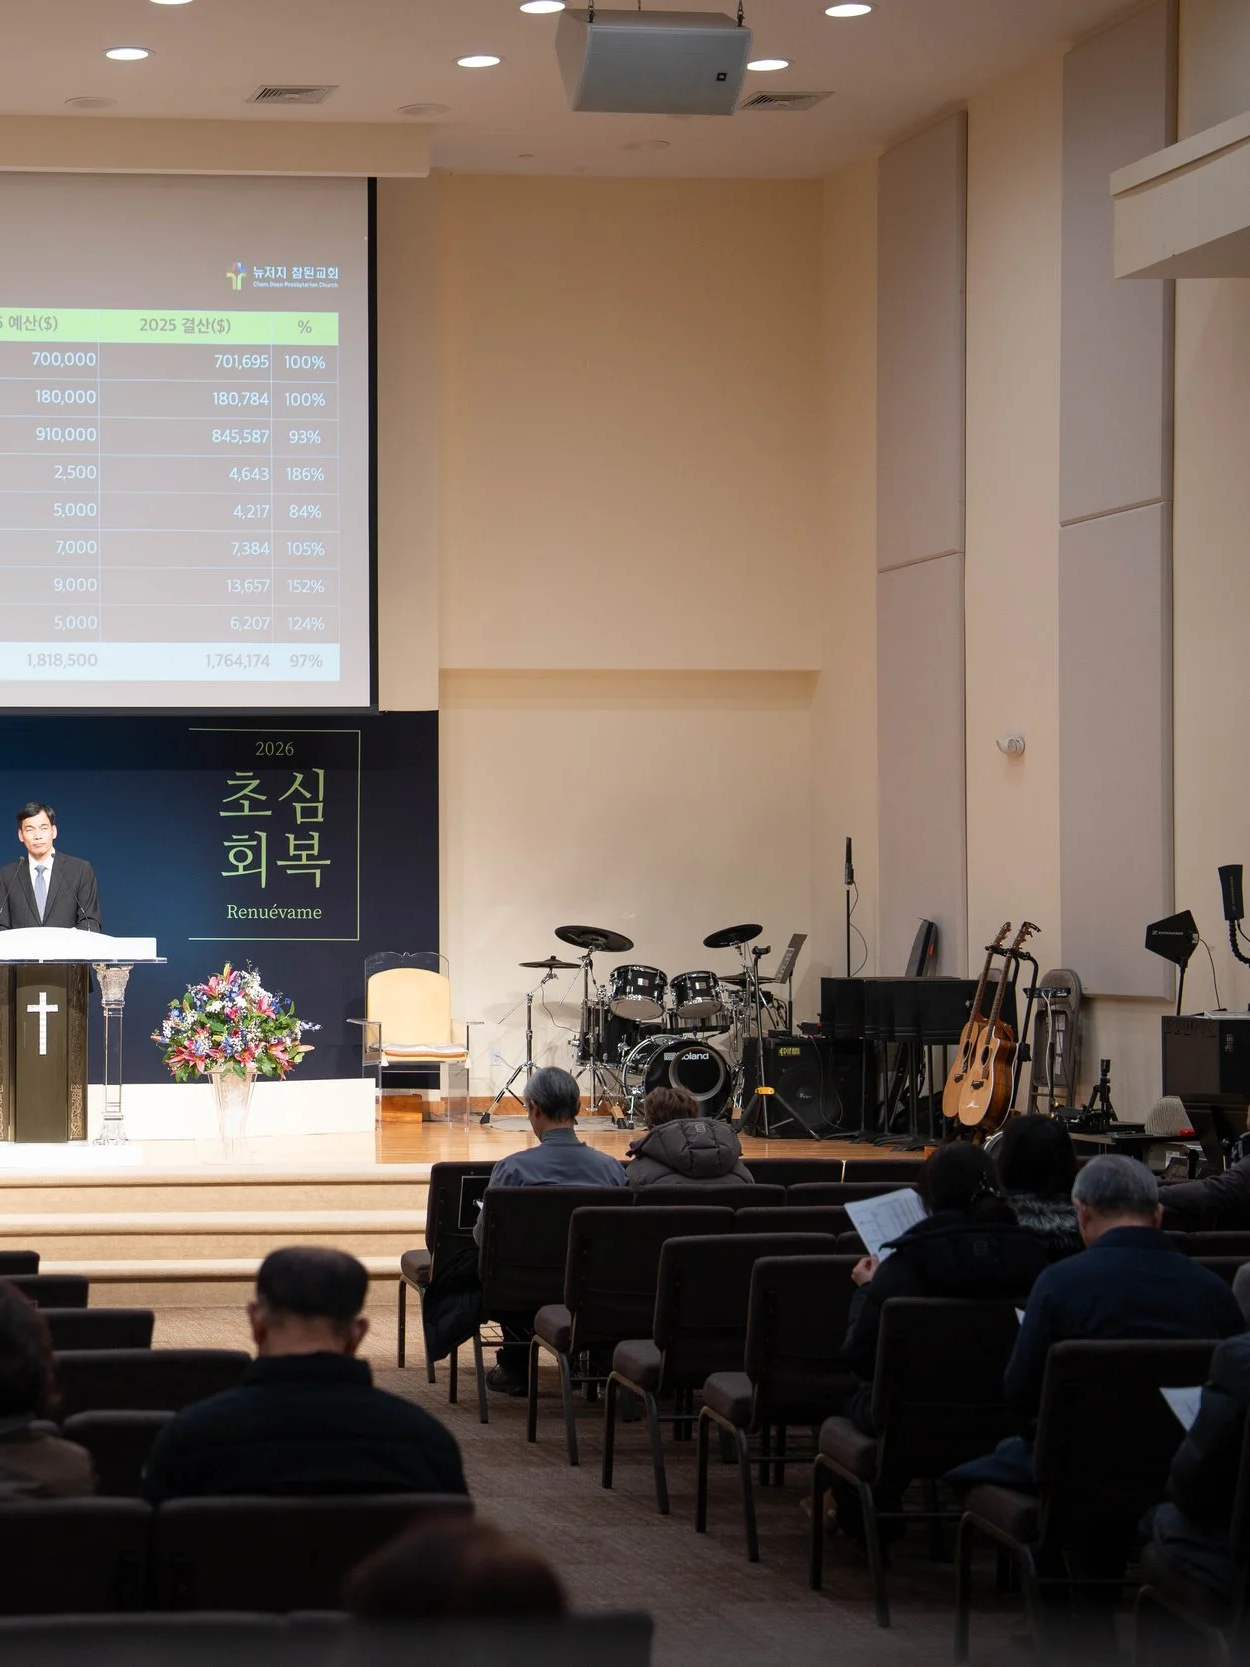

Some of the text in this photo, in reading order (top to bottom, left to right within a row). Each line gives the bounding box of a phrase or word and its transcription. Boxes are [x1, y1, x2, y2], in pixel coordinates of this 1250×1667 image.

[253, 266, 338, 279] 뉴저지 참된교회
[8, 314, 58, 332] 예산($)
[139, 318, 177, 332] 2025
[181, 317, 231, 335] 결산($)
[297, 319, 312, 334] %
[32, 351, 96, 368] 700,000
[214, 354, 269, 370] 701,695
[284, 355, 326, 369] 100%
[35, 389, 96, 405] 180,000
[213, 391, 270, 407] 180,784
[285, 392, 326, 407] 100%
[36, 427, 97, 443] 910,000
[212, 429, 269, 445] 845,587
[289, 430, 321, 444] 93%
[54, 465, 97, 481] 2,500
[229, 467, 269, 482] 4,643
[286, 467, 325, 481] 186%
[53, 502, 97, 518] 5,000
[233, 504, 270, 520] 4,217
[289, 504, 322, 519] 84%
[55, 540, 97, 555] 7,000
[231, 542, 270, 557] 7,384
[286, 542, 326, 556] 105%
[53, 578, 97, 593] 9,000
[226, 579, 270, 594] 13,657
[288, 579, 325, 593] 152%
[54, 615, 98, 631] 5,000
[230, 616, 271, 632] 6,207
[288, 616, 325, 631] 124%
[26, 653, 98, 669] 1,818,500
[205, 653, 271, 669] 1,764,174
[290, 654, 323, 668] 97%
[255, 741, 294, 756] 2026
[219, 768, 324, 825] 초심
[221, 830, 331, 889] 회복
[226, 903, 322, 919] Renuévame
[677, 1052, 709, 1060] oland
